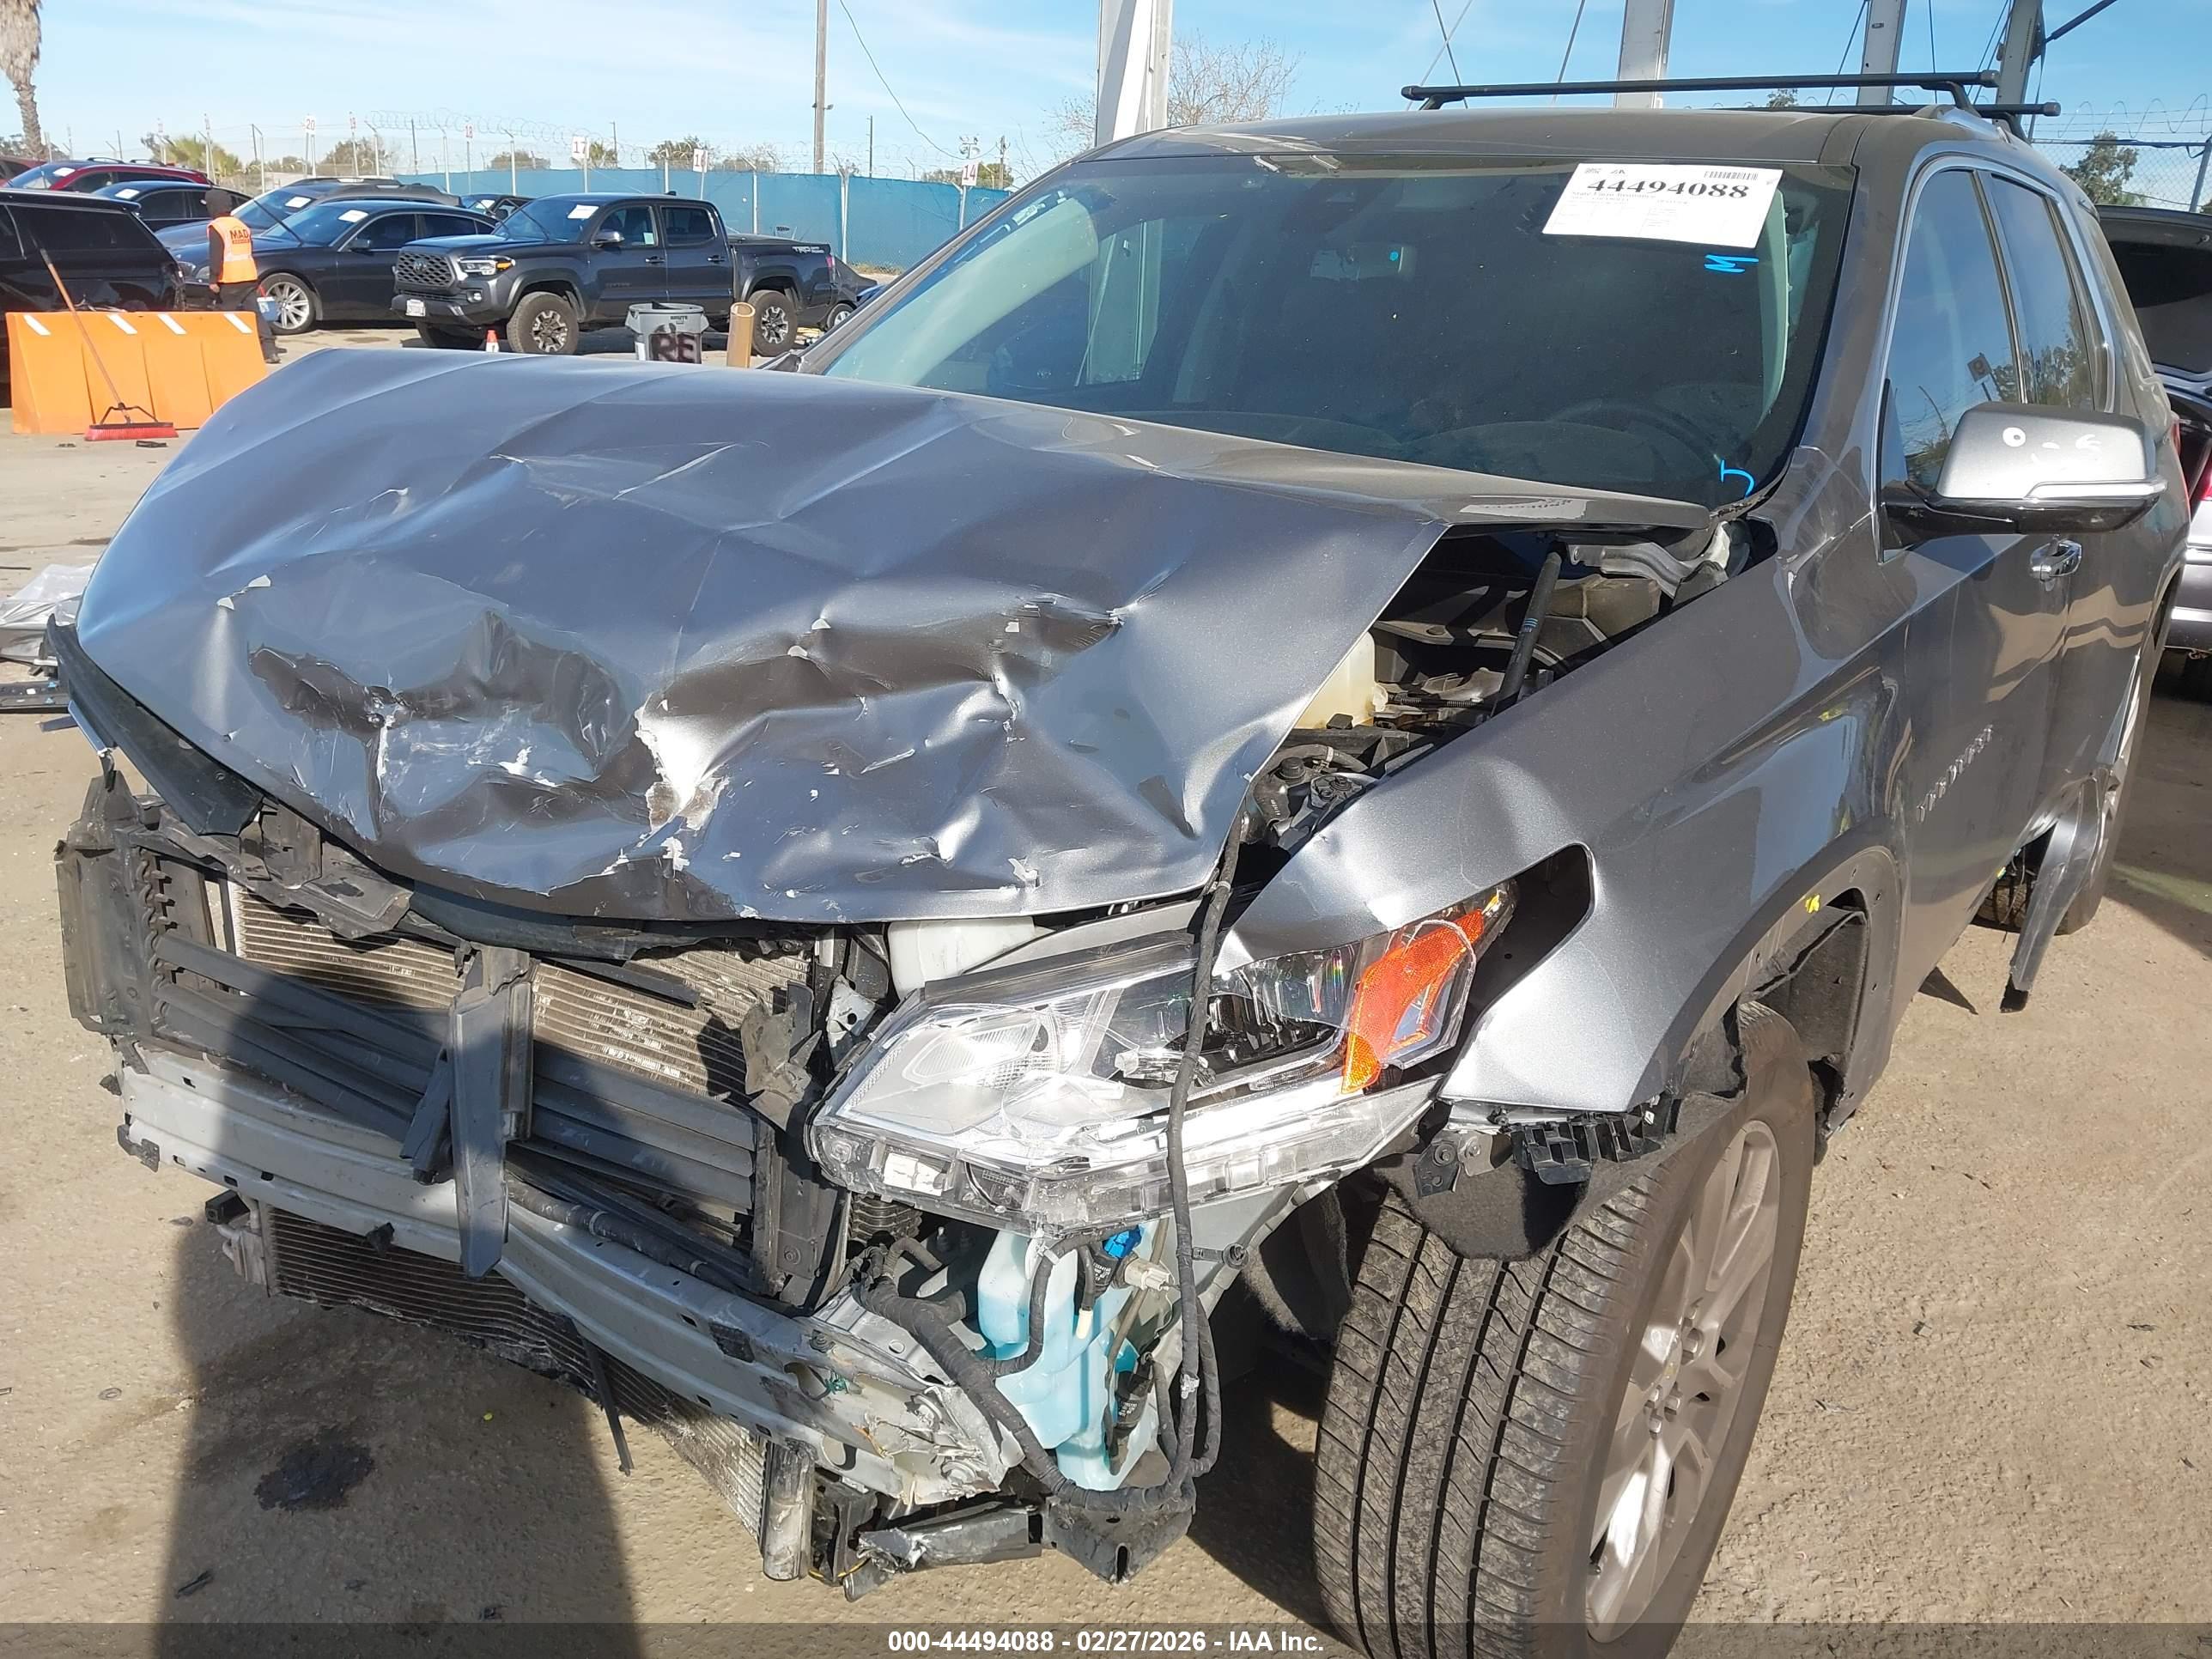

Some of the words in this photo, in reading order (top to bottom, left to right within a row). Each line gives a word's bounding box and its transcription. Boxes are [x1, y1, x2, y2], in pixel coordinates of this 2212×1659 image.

[306, 118, 315, 131] 20
[573, 141, 587, 155] 17
[963, 164, 976, 181] 14
[1588, 179, 1749, 199] 44494088
